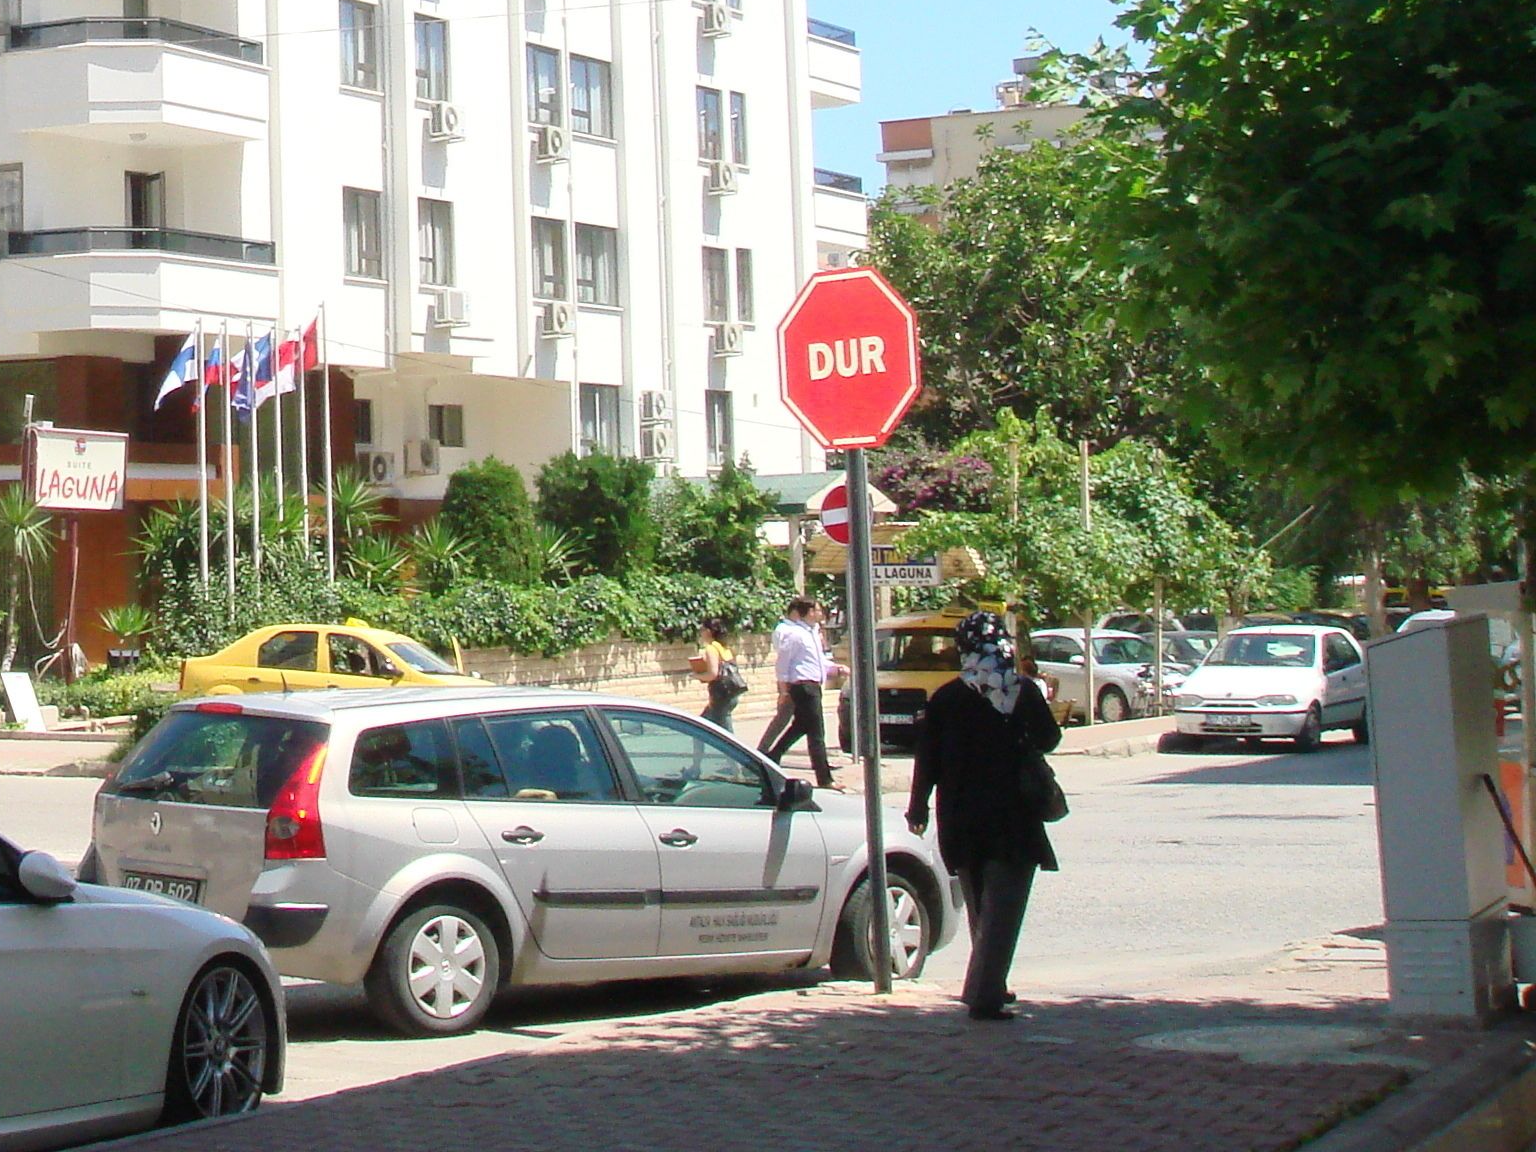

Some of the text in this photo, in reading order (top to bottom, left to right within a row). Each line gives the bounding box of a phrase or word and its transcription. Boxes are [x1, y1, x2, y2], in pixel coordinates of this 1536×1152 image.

[808, 335, 887, 381] DUR
[67, 461, 92, 469] SUITE
[38, 468, 119, 504] LAGUNA
[884, 567, 932, 579] LAGUNA
